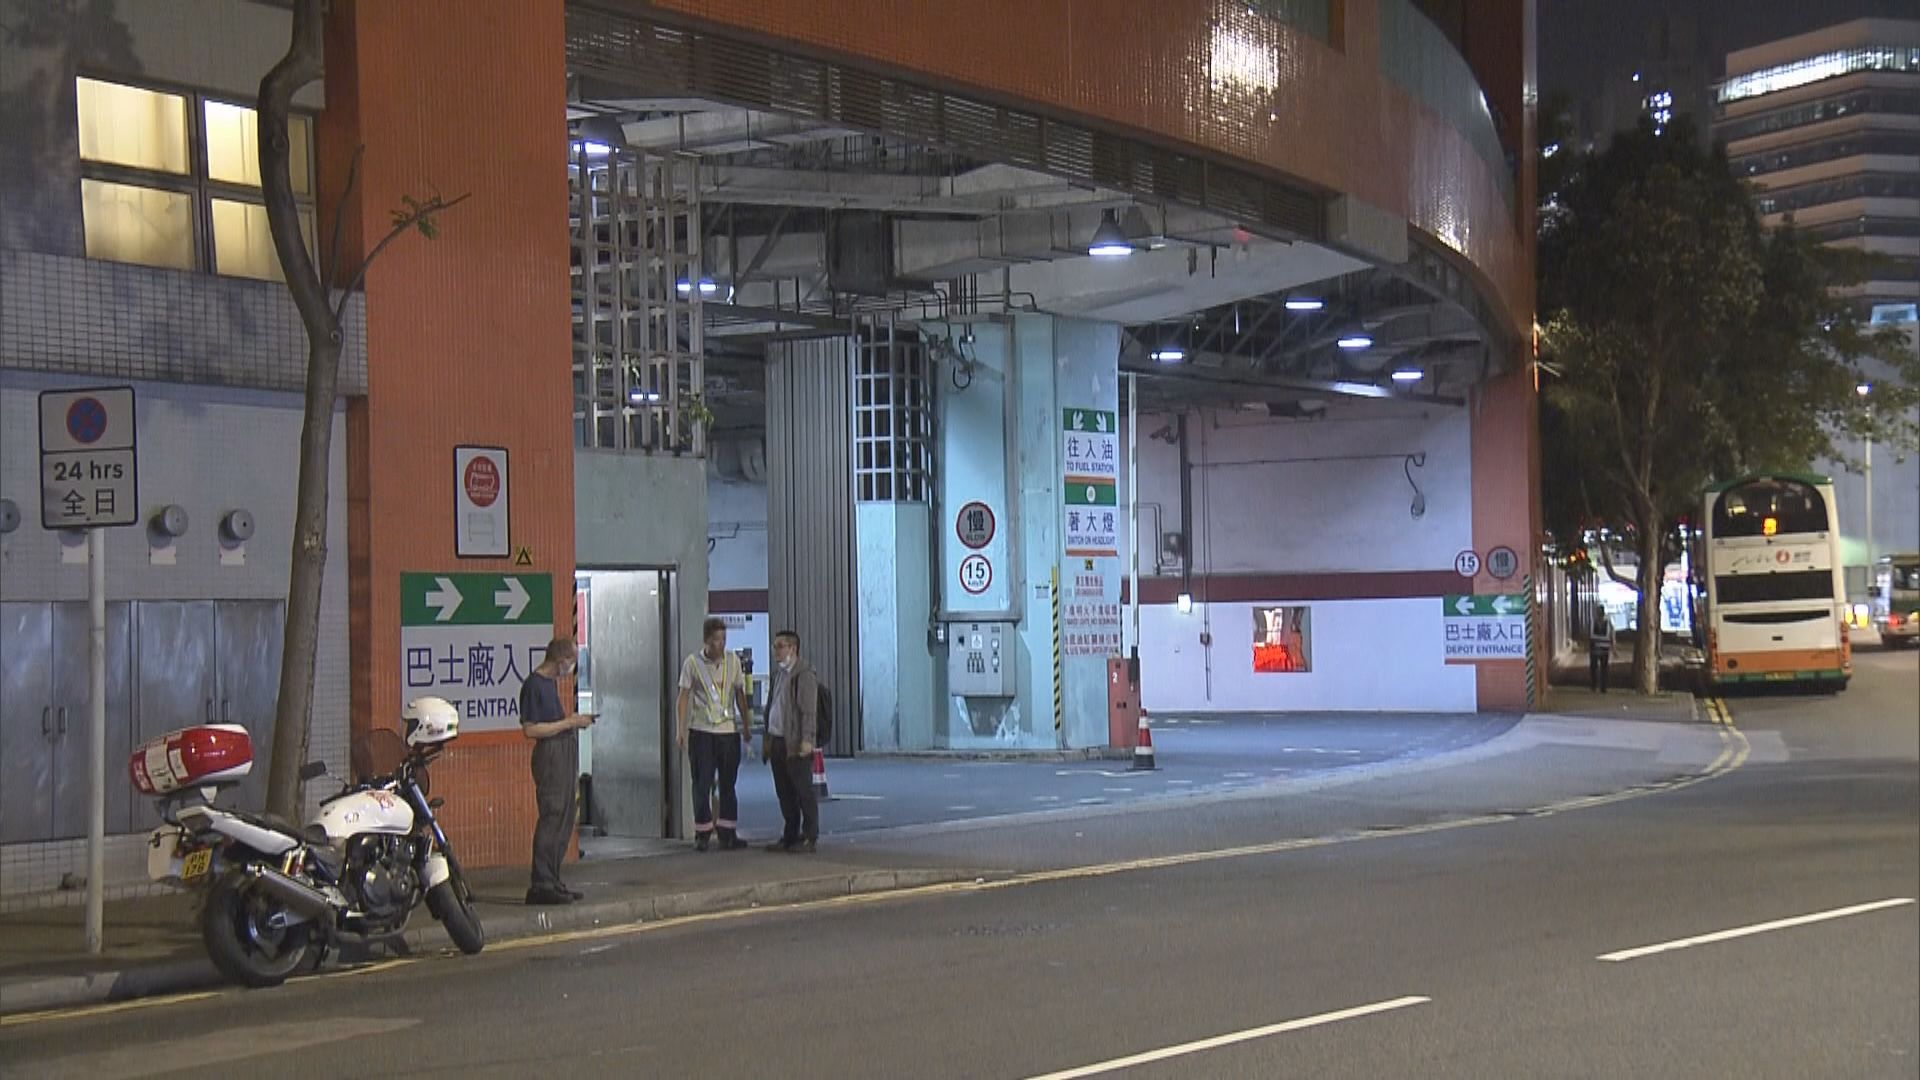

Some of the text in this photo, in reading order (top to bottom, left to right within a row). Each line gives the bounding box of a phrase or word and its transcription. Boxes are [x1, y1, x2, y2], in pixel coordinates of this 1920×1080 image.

[54, 459, 124, 481] 24 hrs
[1066, 461, 1114, 473] TO FUEL STATION
[62, 488, 115, 517] 全日
[1067, 535, 1084, 545] SWITCH
[1085, 535, 1091, 545] ON
[965, 561, 985, 579] 15
[1460, 555, 1475, 569] 15
[1445, 622, 1523, 641] 巴士廠入口
[1445, 644, 1523, 654] DEPOT ENTRANCE
[466, 697, 519, 719] ENTRA
